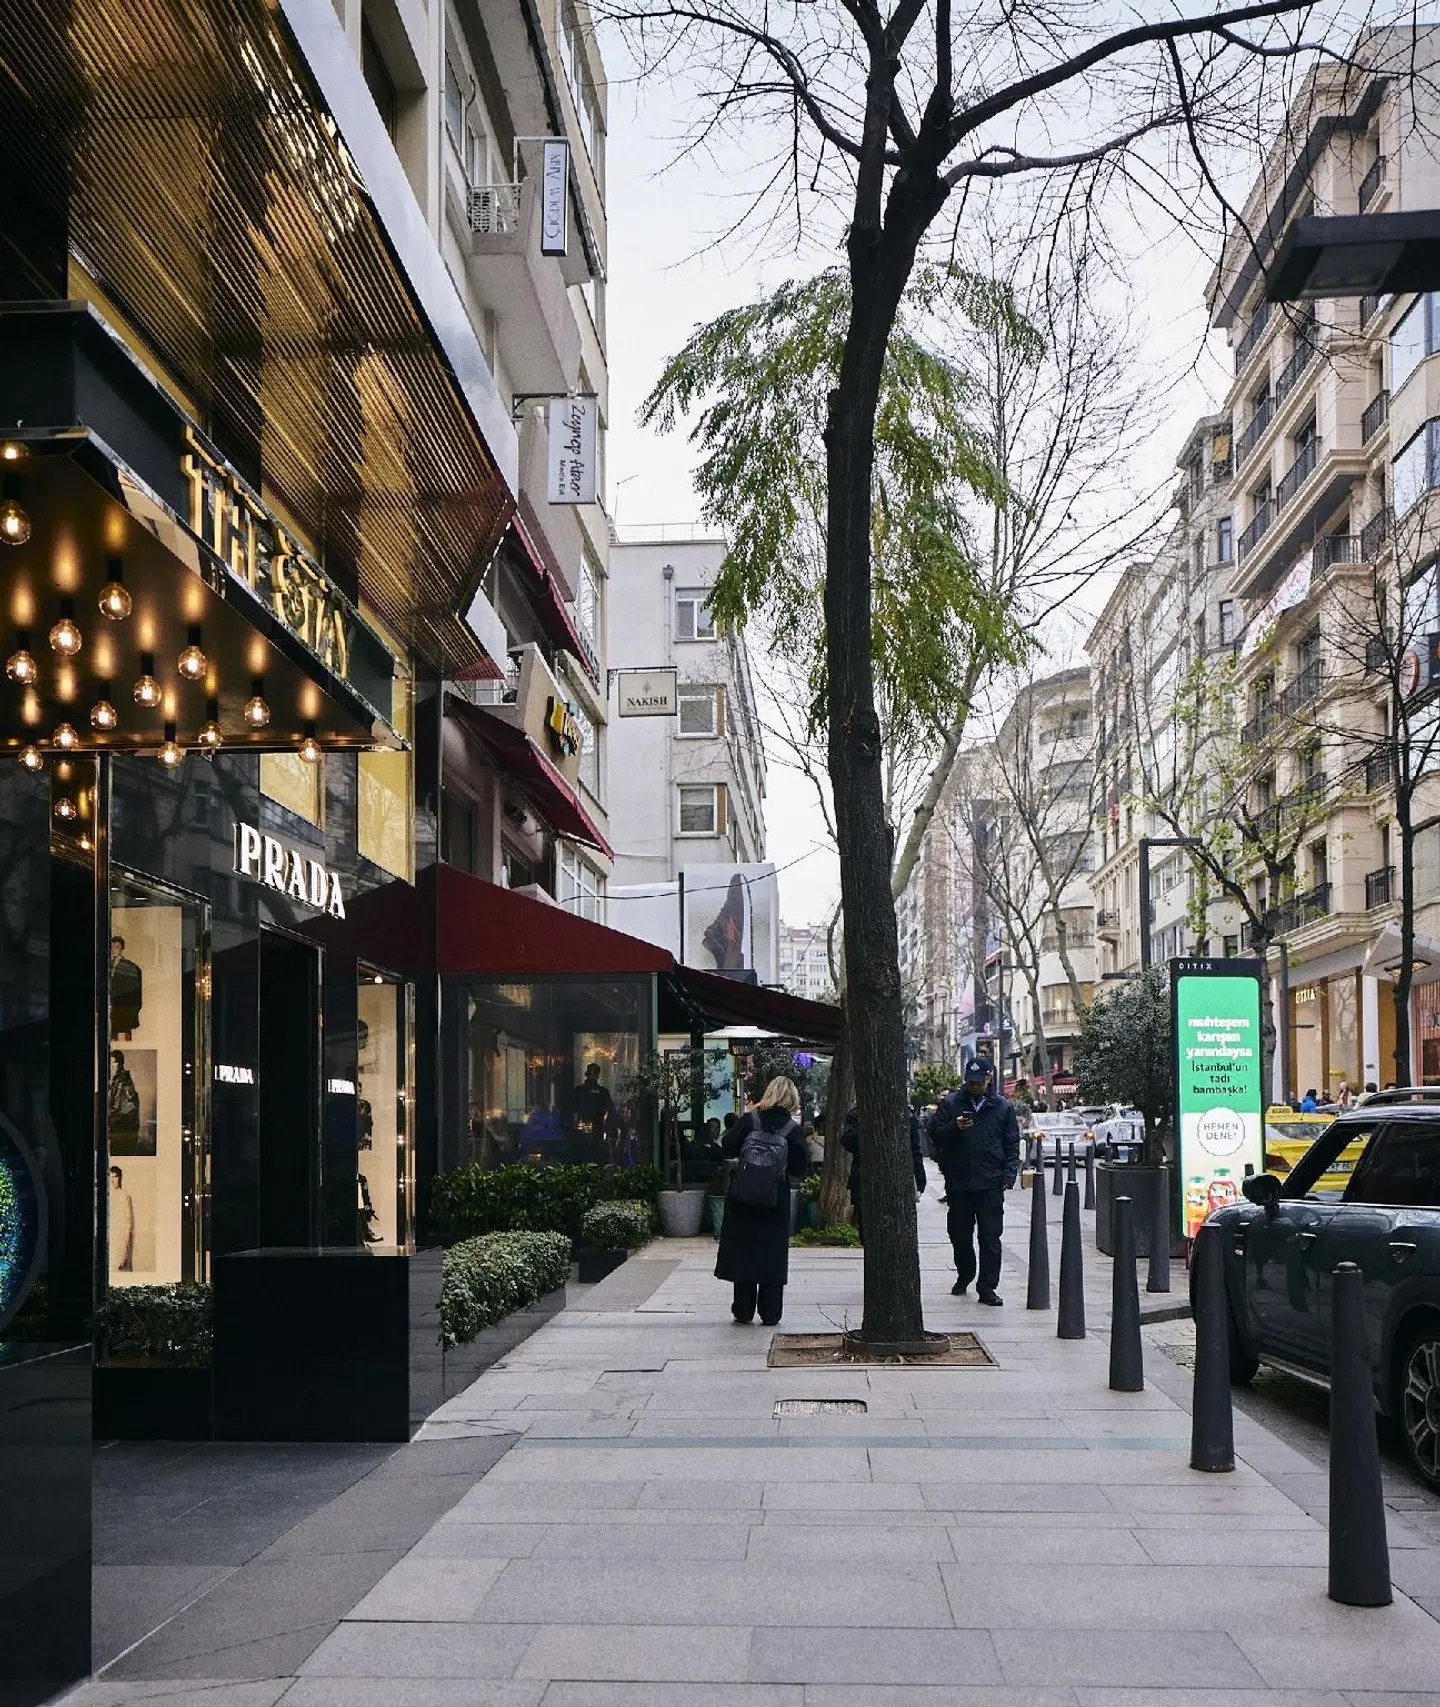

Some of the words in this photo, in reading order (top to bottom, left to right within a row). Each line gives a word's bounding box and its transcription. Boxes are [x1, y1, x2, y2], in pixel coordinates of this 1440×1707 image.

[562, 404, 586, 455] Zeynep
[232, 822, 346, 920] PRADA
[1192, 1060, 1248, 1072] İstanbul'un
[1210, 1074, 1230, 1083] tadı
[1193, 1085, 1247, 1096] bambaşka!
